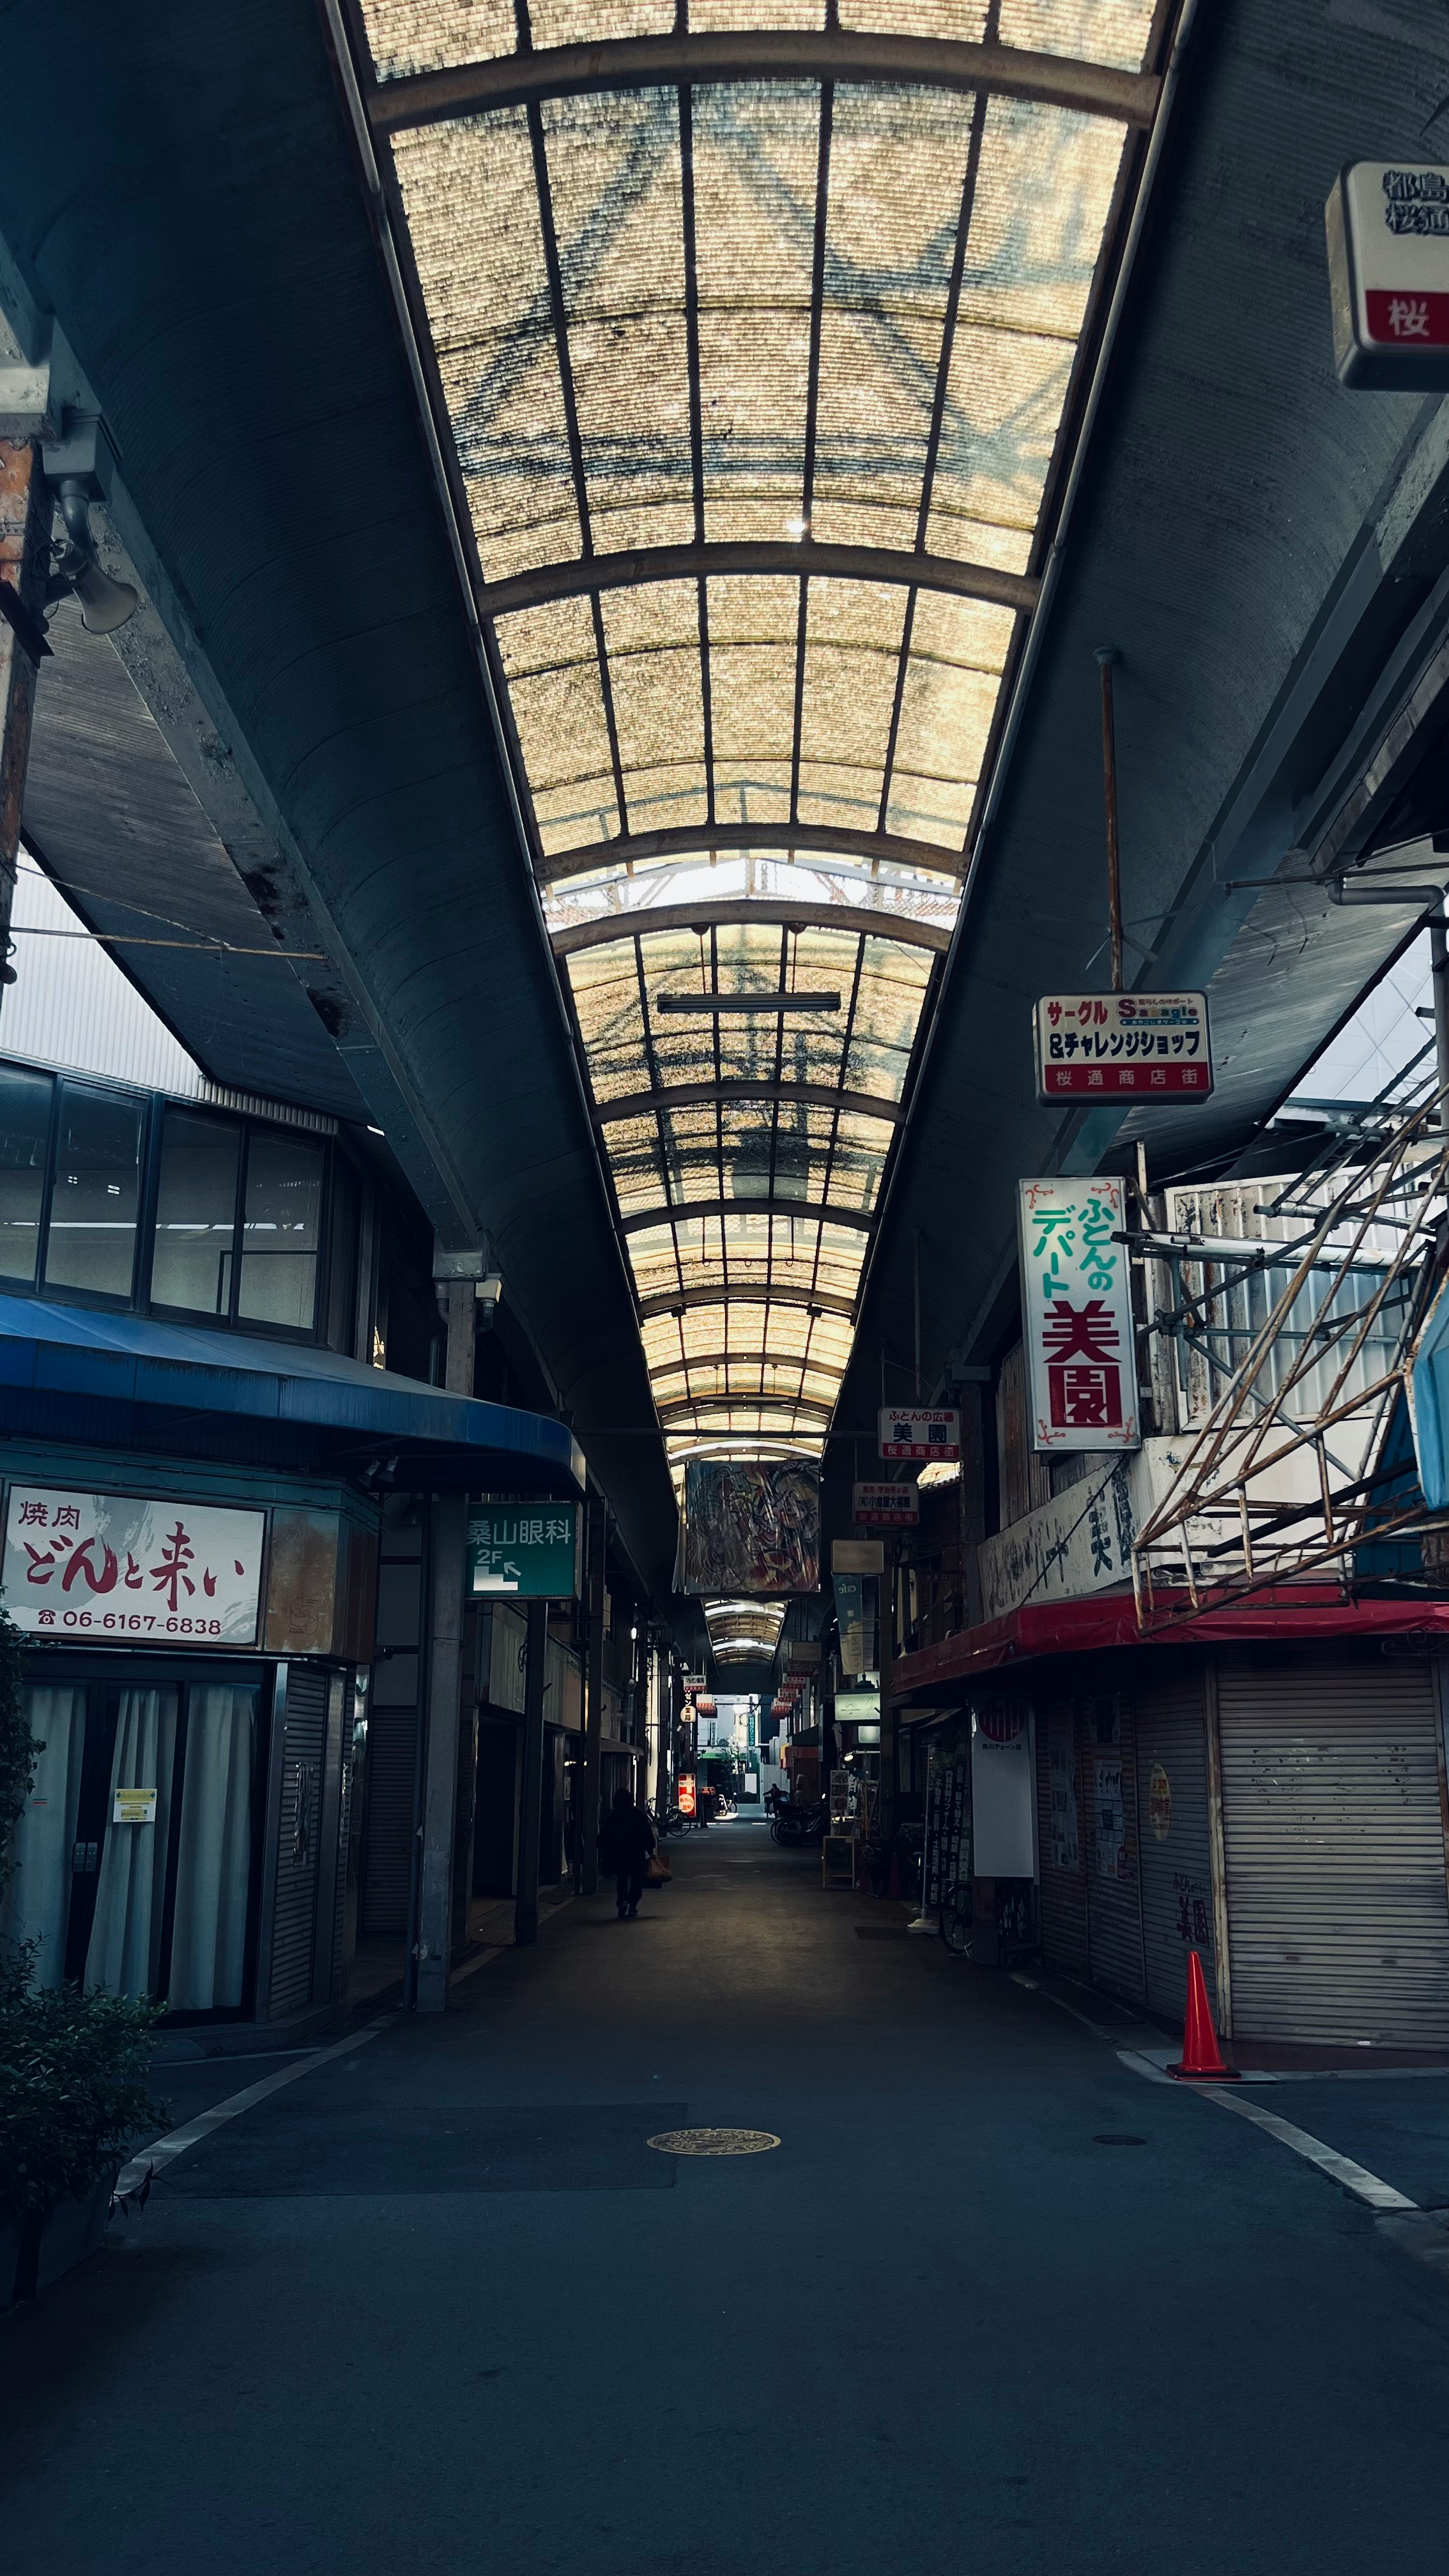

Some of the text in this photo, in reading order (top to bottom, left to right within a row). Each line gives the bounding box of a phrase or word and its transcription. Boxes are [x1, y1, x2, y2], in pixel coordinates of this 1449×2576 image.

[1388, 298, 1430, 336] 桜
[1056, 1069, 1198, 1085] 桜通商店街
[1032, 1204, 1076, 1299] デパート
[1078, 1198, 1117, 1292] ふとんの
[1042, 1300, 1123, 1428] 美園
[887, 1445, 954, 1457] 桜通商店街
[18, 1501, 80, 1530] 焼肉
[466, 1519, 571, 1545] 桑山眼科
[23, 1522, 245, 1612] どんと来い
[477, 1549, 503, 1564] 2F
[63, 1611, 222, 1635] 06-6167-6838
